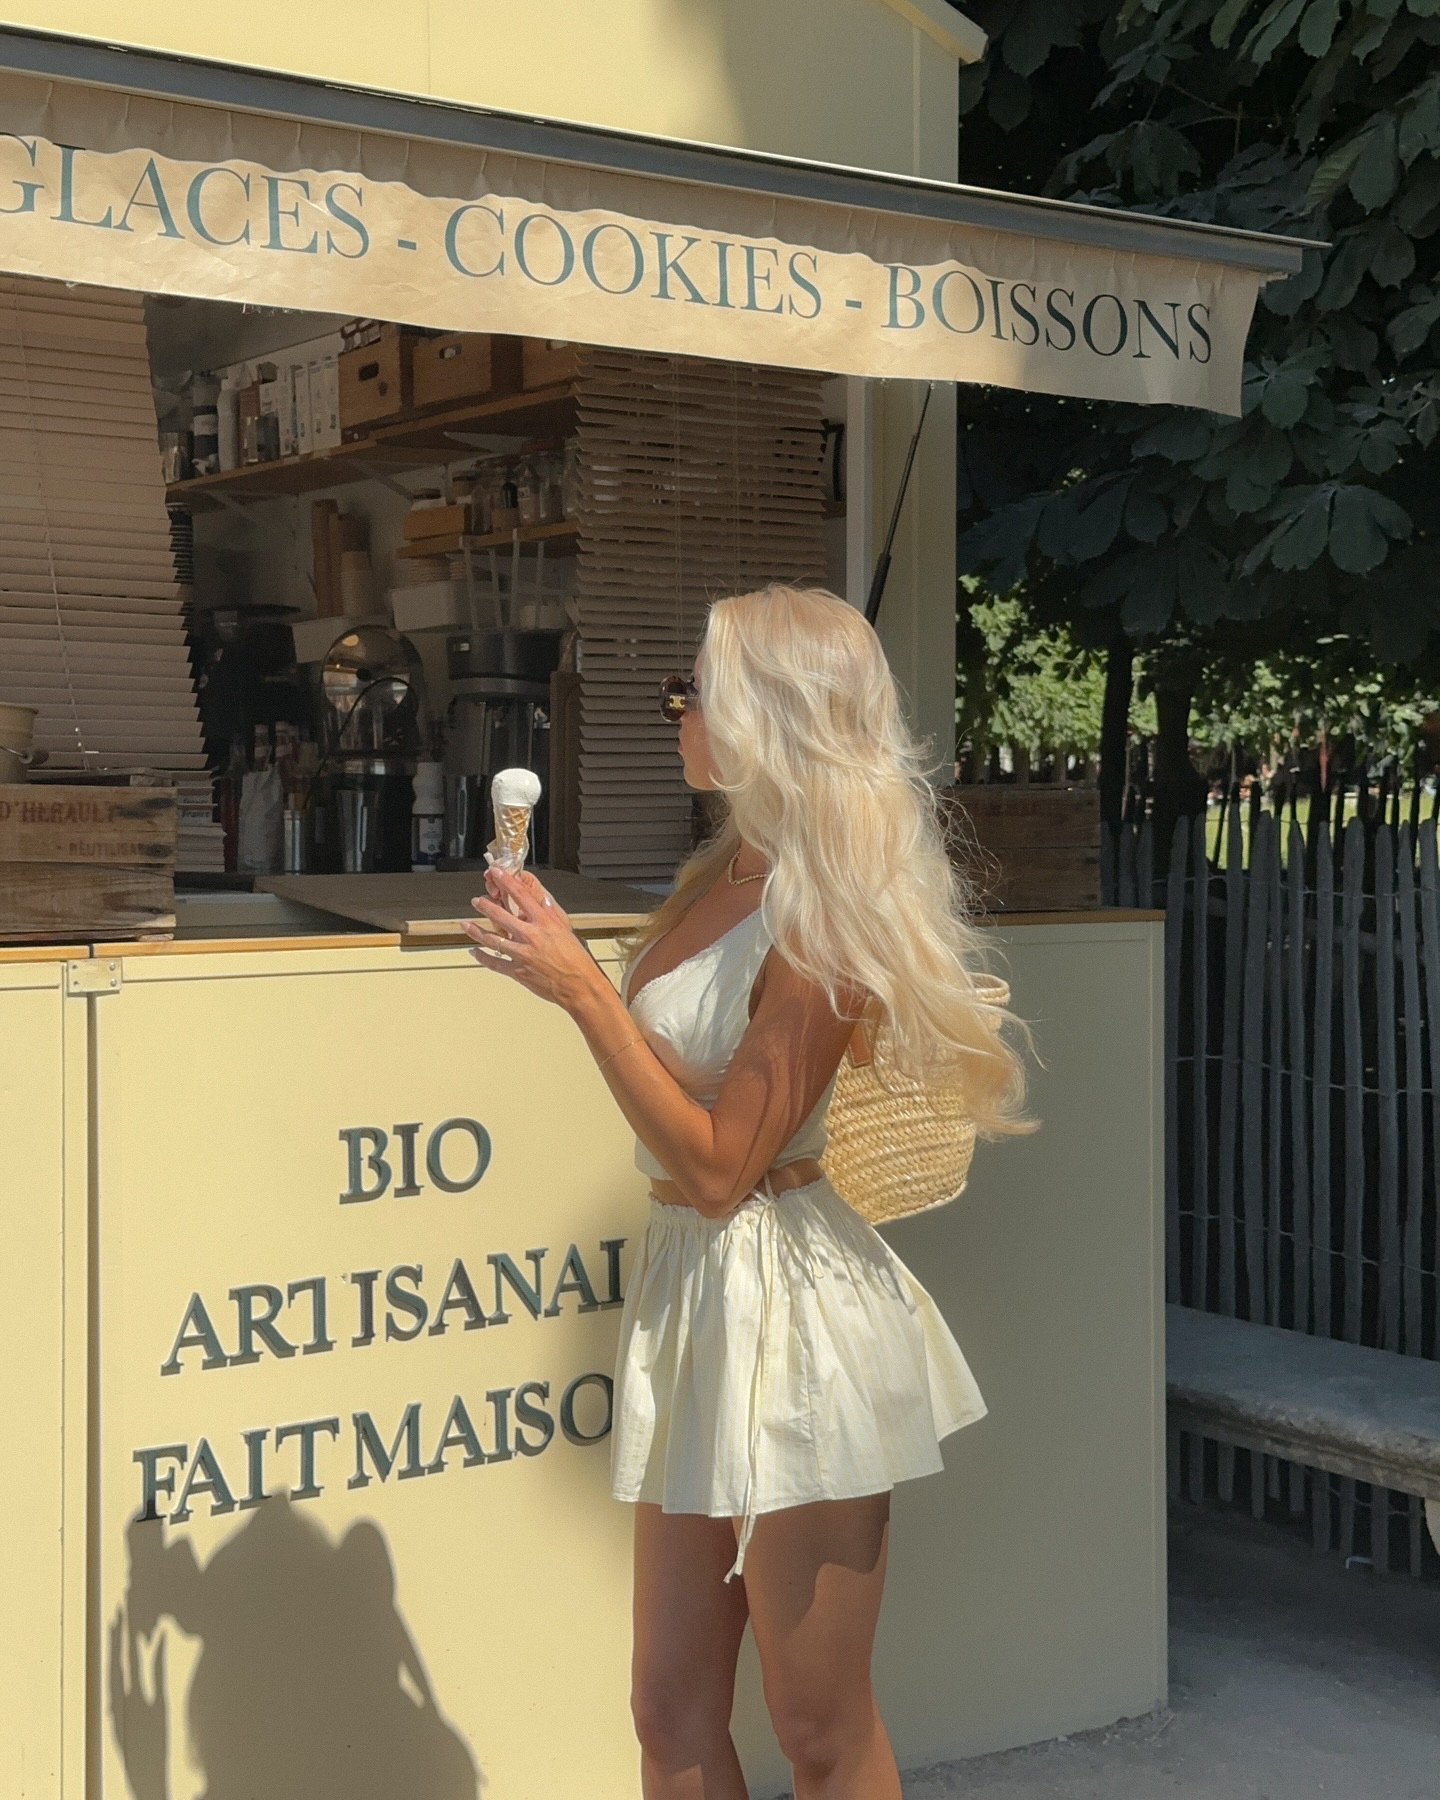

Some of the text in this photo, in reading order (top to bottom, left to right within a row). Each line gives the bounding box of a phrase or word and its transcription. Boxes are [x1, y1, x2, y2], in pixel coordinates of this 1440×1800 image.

[0, 132, 369, 258] GLACES
[446, 204, 822, 318] COOKIES
[882, 265, 1211, 364] BOISSONS
[339, 1117, 492, 1204] BIO
[133, 1374, 613, 1523] FAIT MAISO
